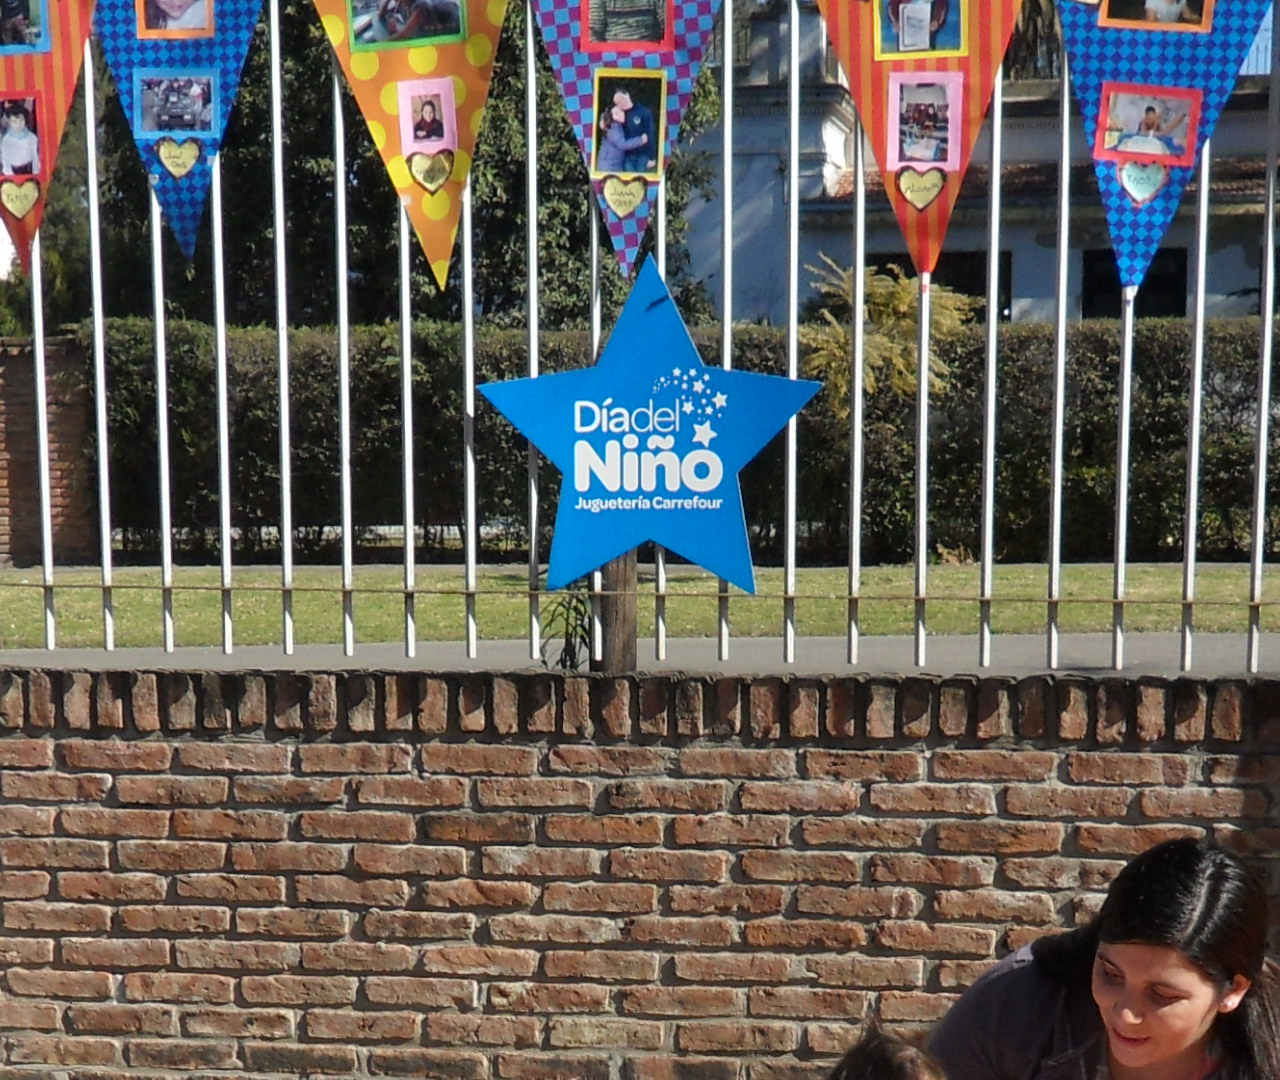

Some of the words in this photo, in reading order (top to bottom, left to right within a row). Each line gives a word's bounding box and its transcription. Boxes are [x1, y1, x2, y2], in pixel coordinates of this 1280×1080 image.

[574, 433, 724, 492] Niño
[574, 496, 651, 513] Juguetería
[651, 496, 724, 510] Carrefour
